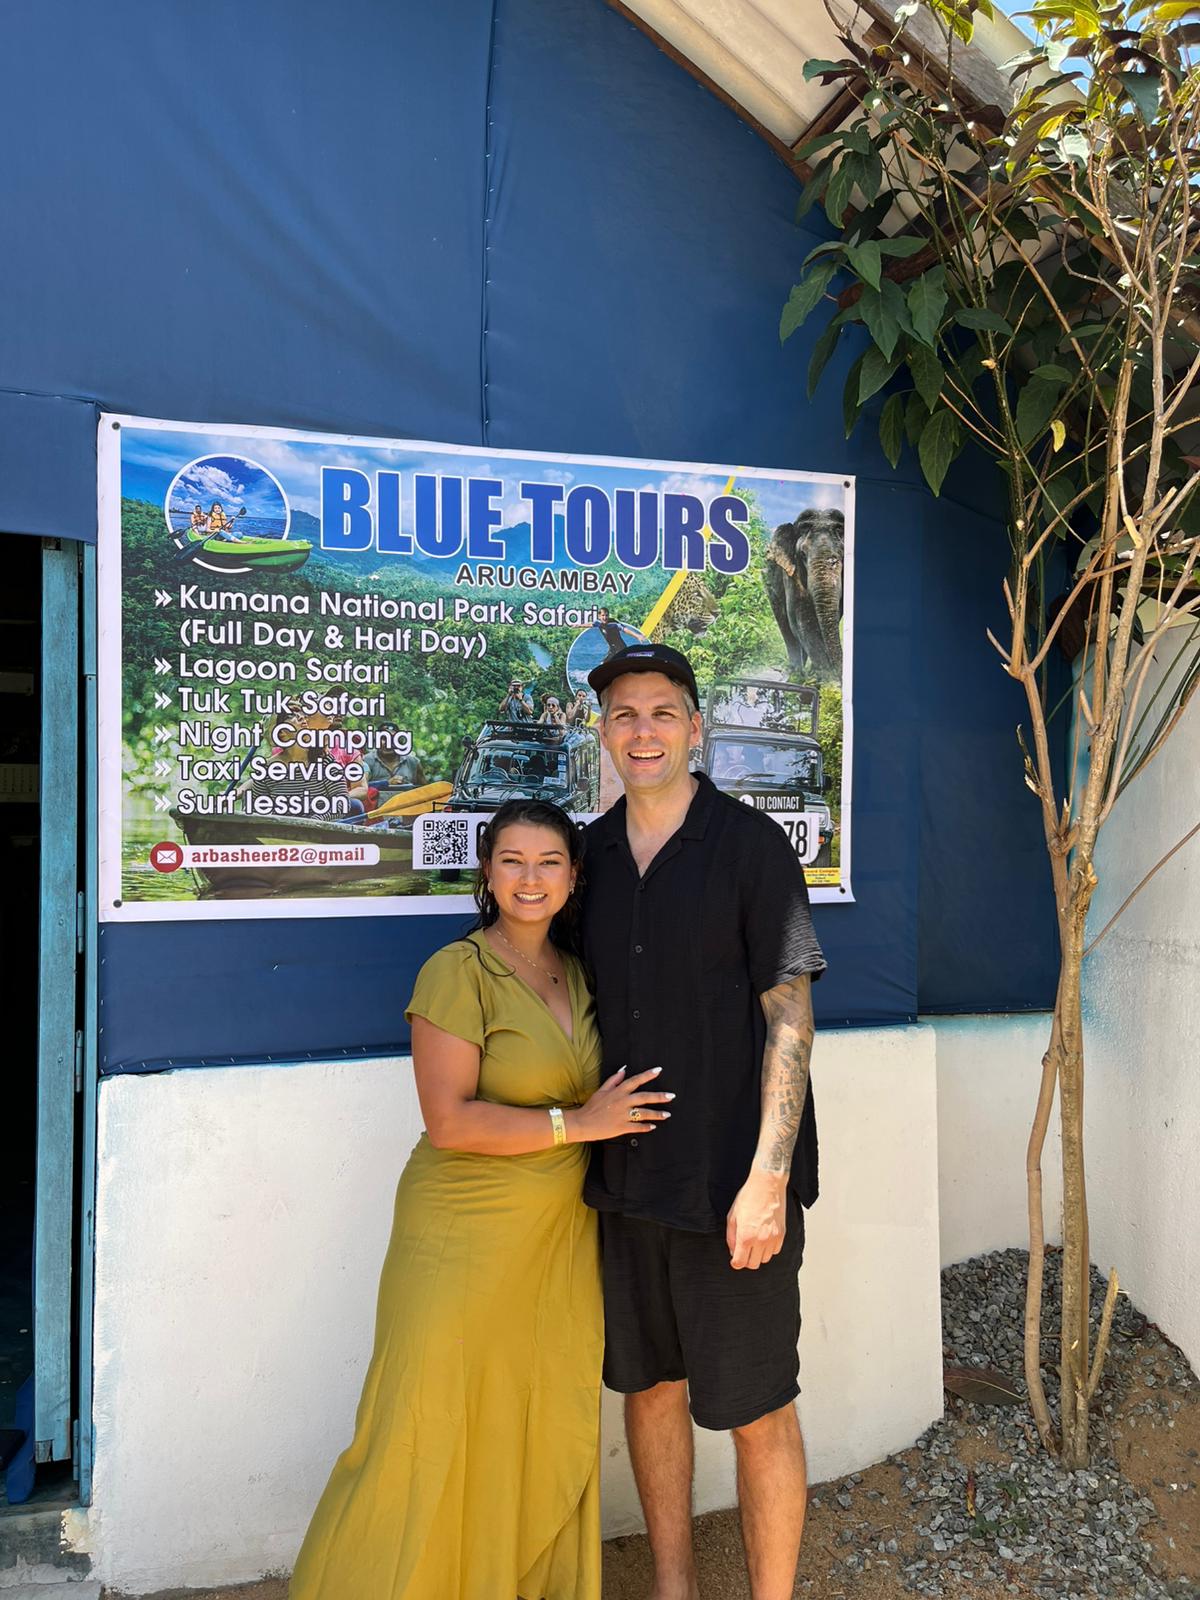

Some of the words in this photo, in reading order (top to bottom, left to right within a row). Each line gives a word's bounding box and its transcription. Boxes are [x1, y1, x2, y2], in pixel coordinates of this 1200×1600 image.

[320, 466, 506, 560] BLUE
[520, 481, 751, 575] TOURS
[456, 565, 634, 593] ARUGAMBAY
[180, 584, 309, 615] Kumana
[320, 592, 444, 621] National
[454, 599, 514, 624] Park
[523, 604, 600, 627] Safari
[179, 618, 242, 647] (Full
[254, 623, 314, 652] Day
[323, 625, 344, 651] &
[354, 626, 411, 653] Half
[420, 630, 487, 660] Day)
[179, 653, 296, 684] Lagoon
[305, 657, 390, 684] Safari
[178, 687, 231, 713] Tuk
[240, 689, 292, 715] Tuk
[302, 691, 386, 717] Safari
[179, 721, 263, 749] Night
[271, 726, 413, 754] Camping
[178, 755, 240, 781] Taxi
[250, 757, 364, 782] Service
[178, 789, 237, 815] Surf
[246, 790, 350, 814] lession
[756, 796, 766, 810] TO
[767, 796, 800, 810] CONTACT
[191, 848, 365, 864] arbasheer82@gmail
